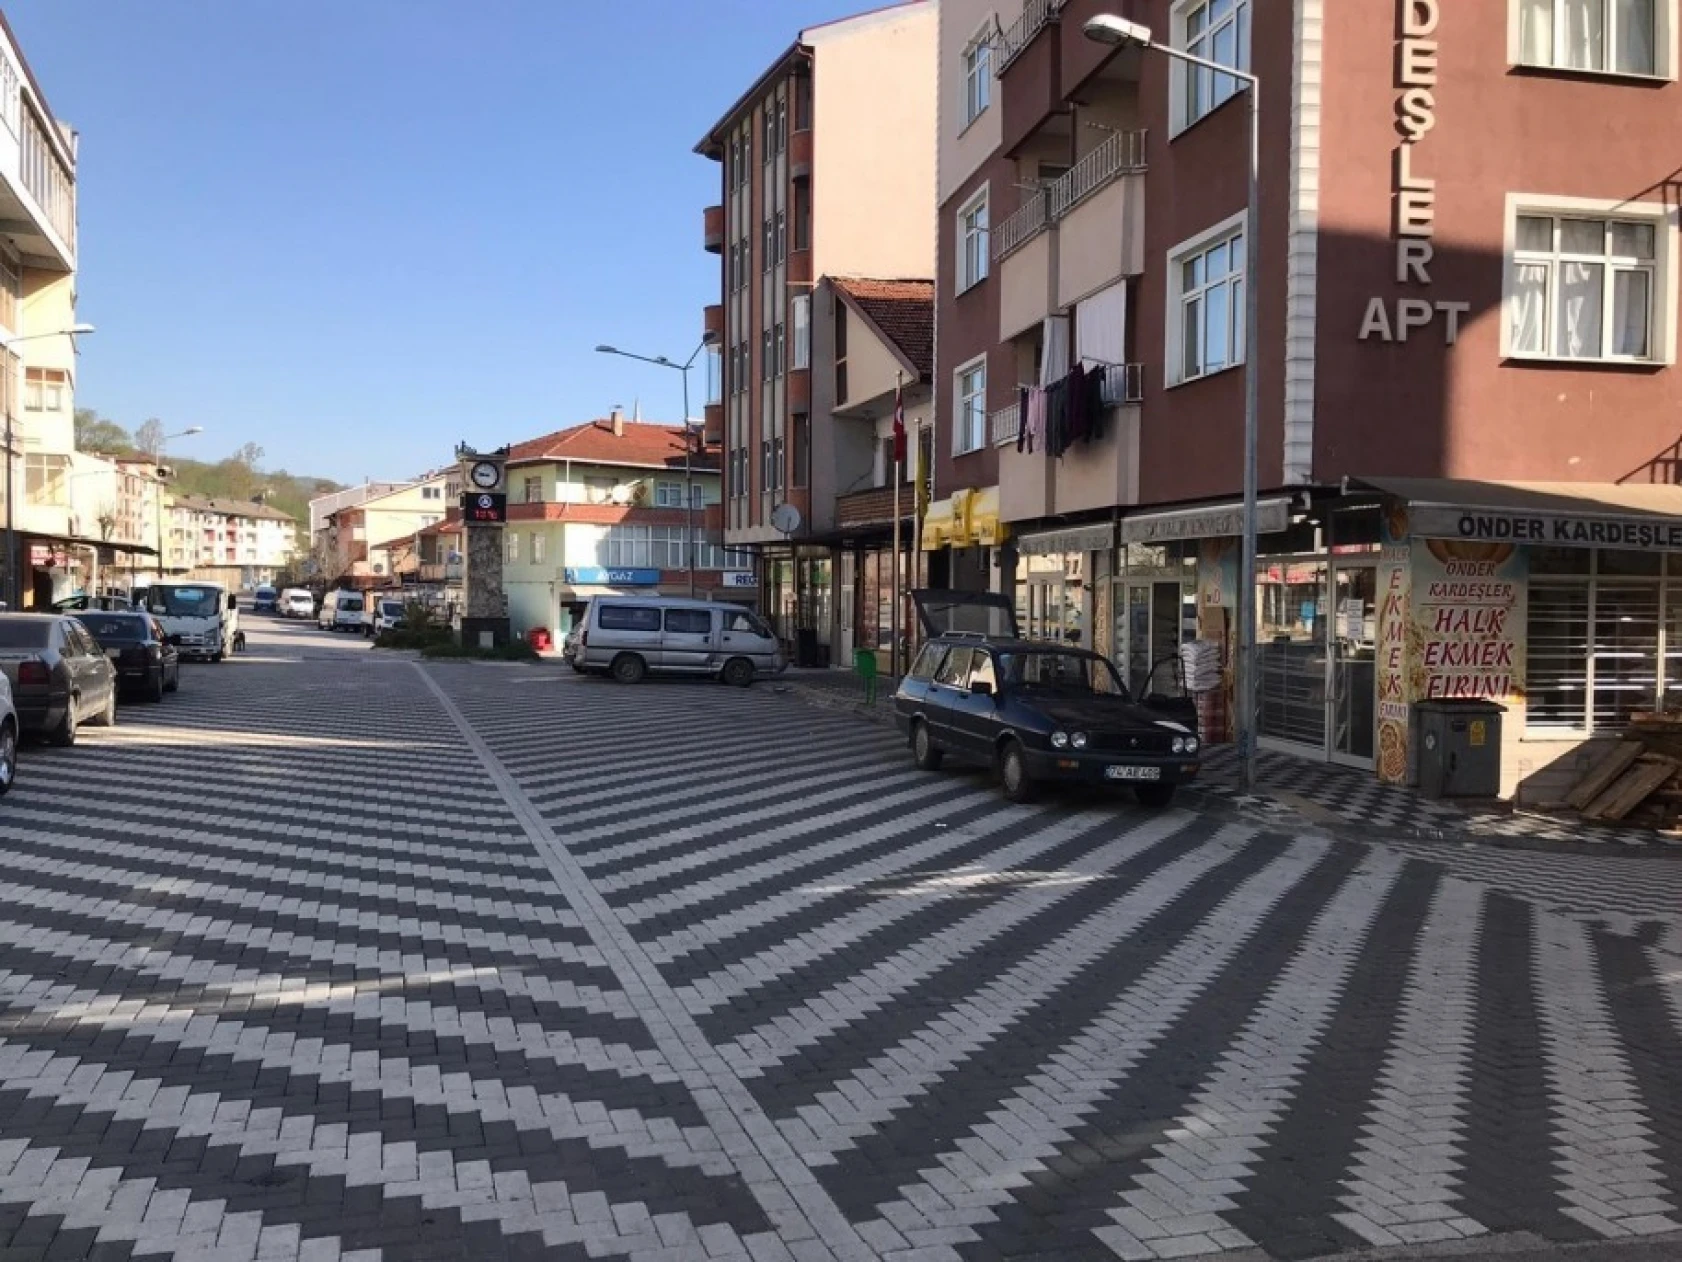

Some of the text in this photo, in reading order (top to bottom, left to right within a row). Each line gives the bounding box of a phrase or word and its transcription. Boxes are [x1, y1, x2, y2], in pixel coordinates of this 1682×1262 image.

[1357, 297, 1471, 346] APT
[1457, 512, 1545, 539] ÖNDER
[1446, 560, 1496, 577] ÖNDER
[1429, 582, 1512, 601] KARDEŞLER
[1435, 608, 1506, 634] HALK
[1424, 641, 1515, 667] EKMEK
